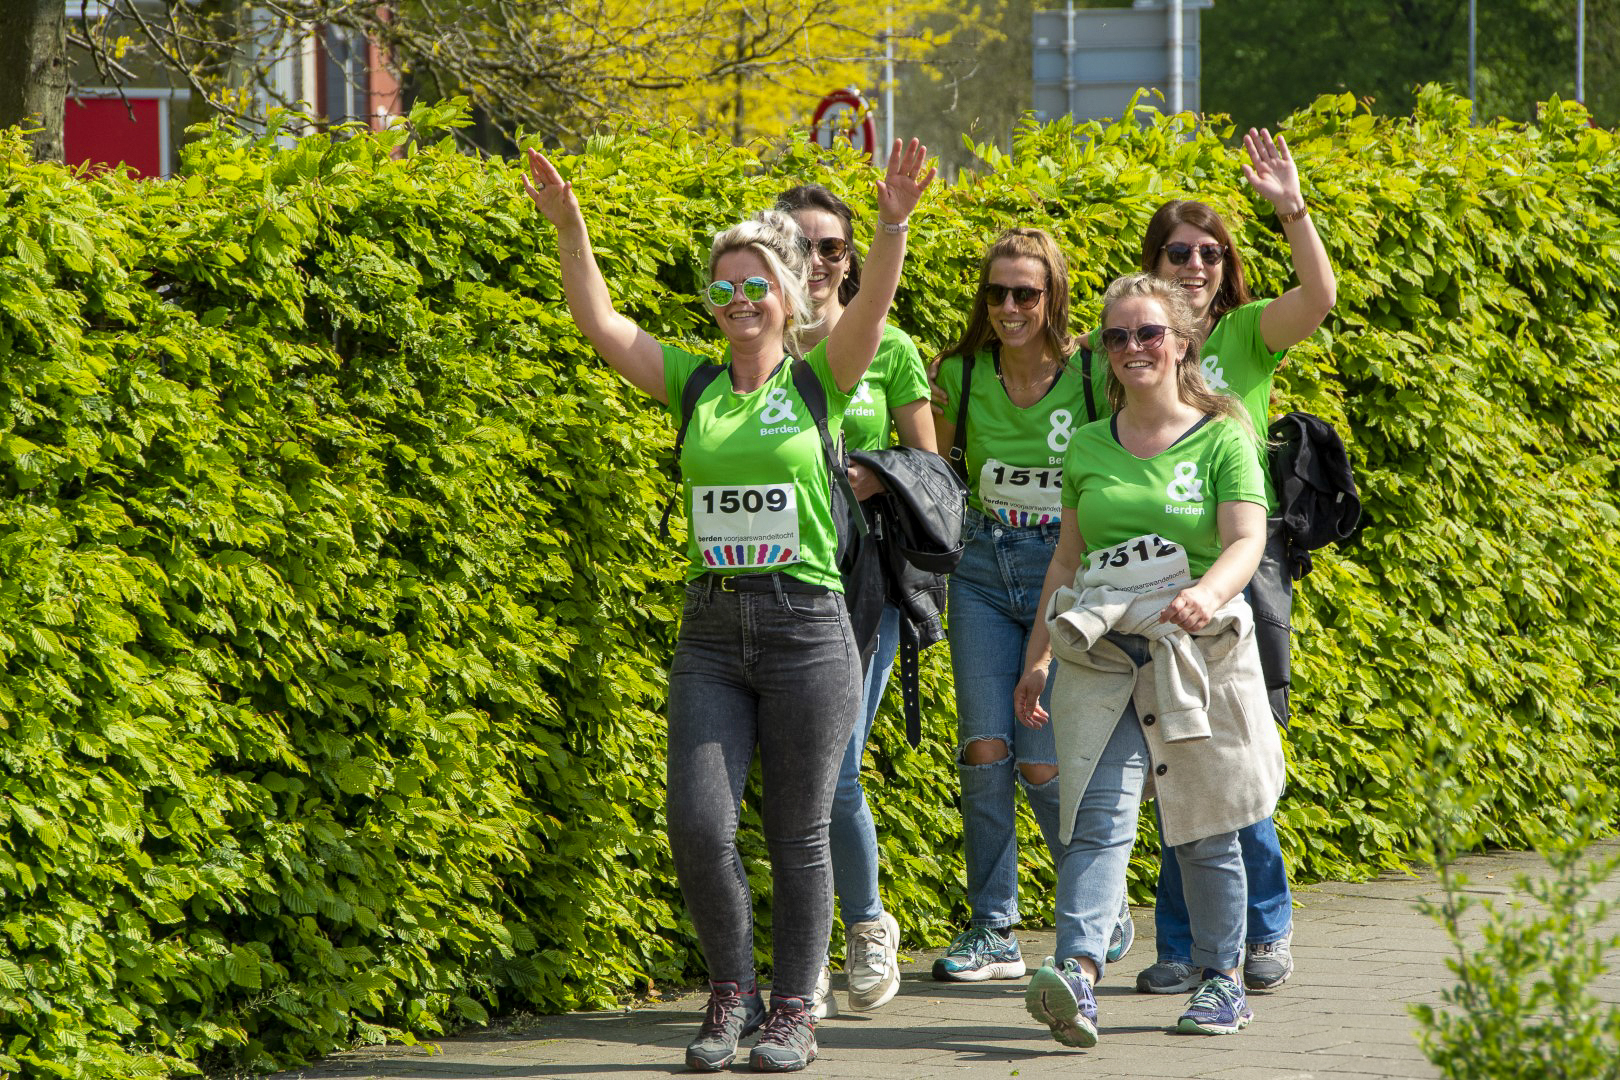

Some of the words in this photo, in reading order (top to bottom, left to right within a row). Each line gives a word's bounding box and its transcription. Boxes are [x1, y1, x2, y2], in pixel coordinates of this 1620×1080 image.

[844, 405, 875, 416] erden
[760, 424, 800, 436] Berden
[702, 488, 787, 514] 1509
[1165, 504, 1205, 515] Berden
[723, 532, 794, 543] voorjaarswandeltocht
[1098, 536, 1177, 569] 1512
